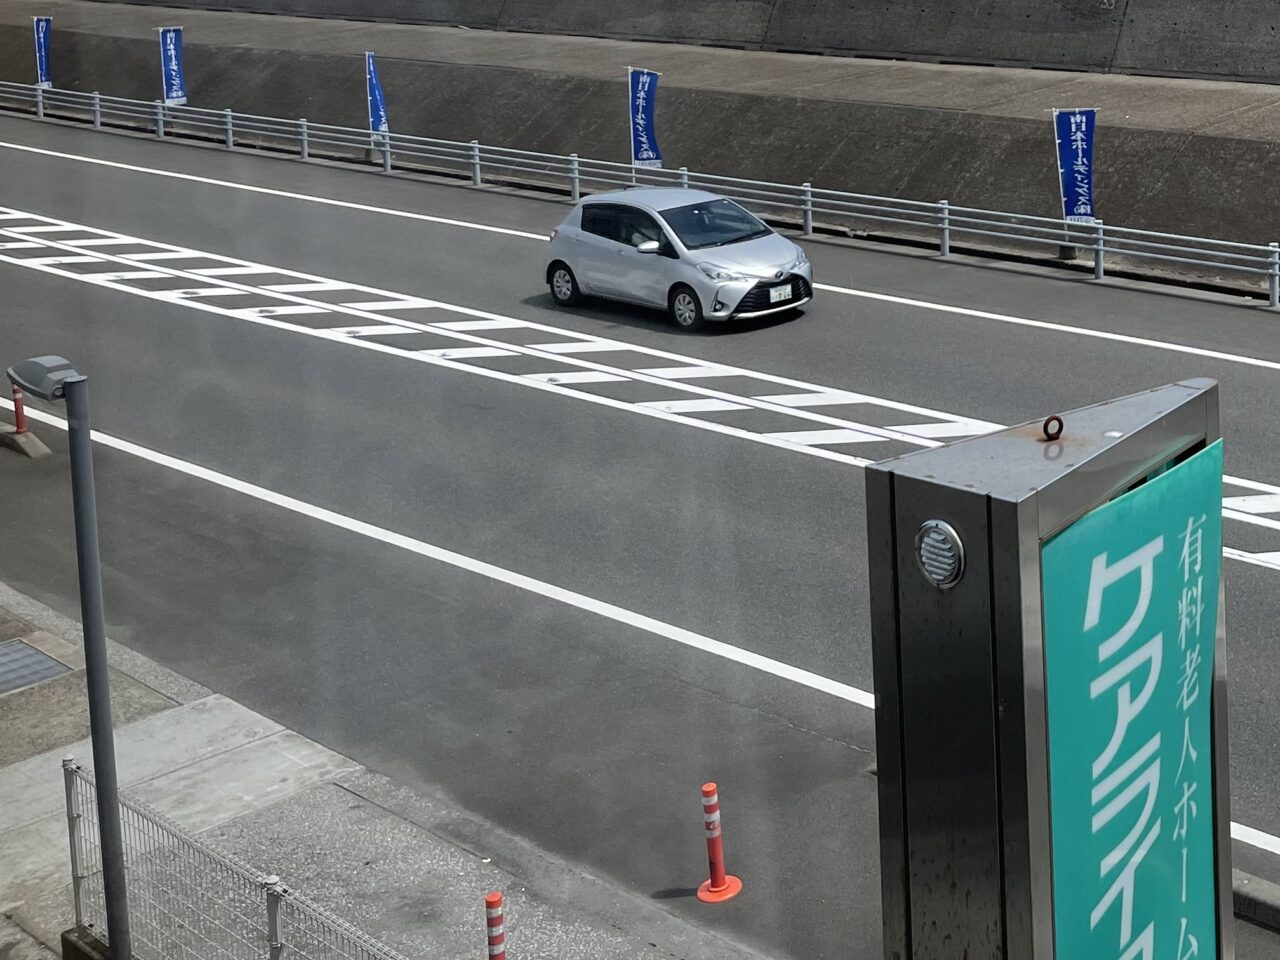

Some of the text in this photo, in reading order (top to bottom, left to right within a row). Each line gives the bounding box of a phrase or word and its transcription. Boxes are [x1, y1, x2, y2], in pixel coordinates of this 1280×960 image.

[1173, 515, 1207, 960] 有料老人ホーム
